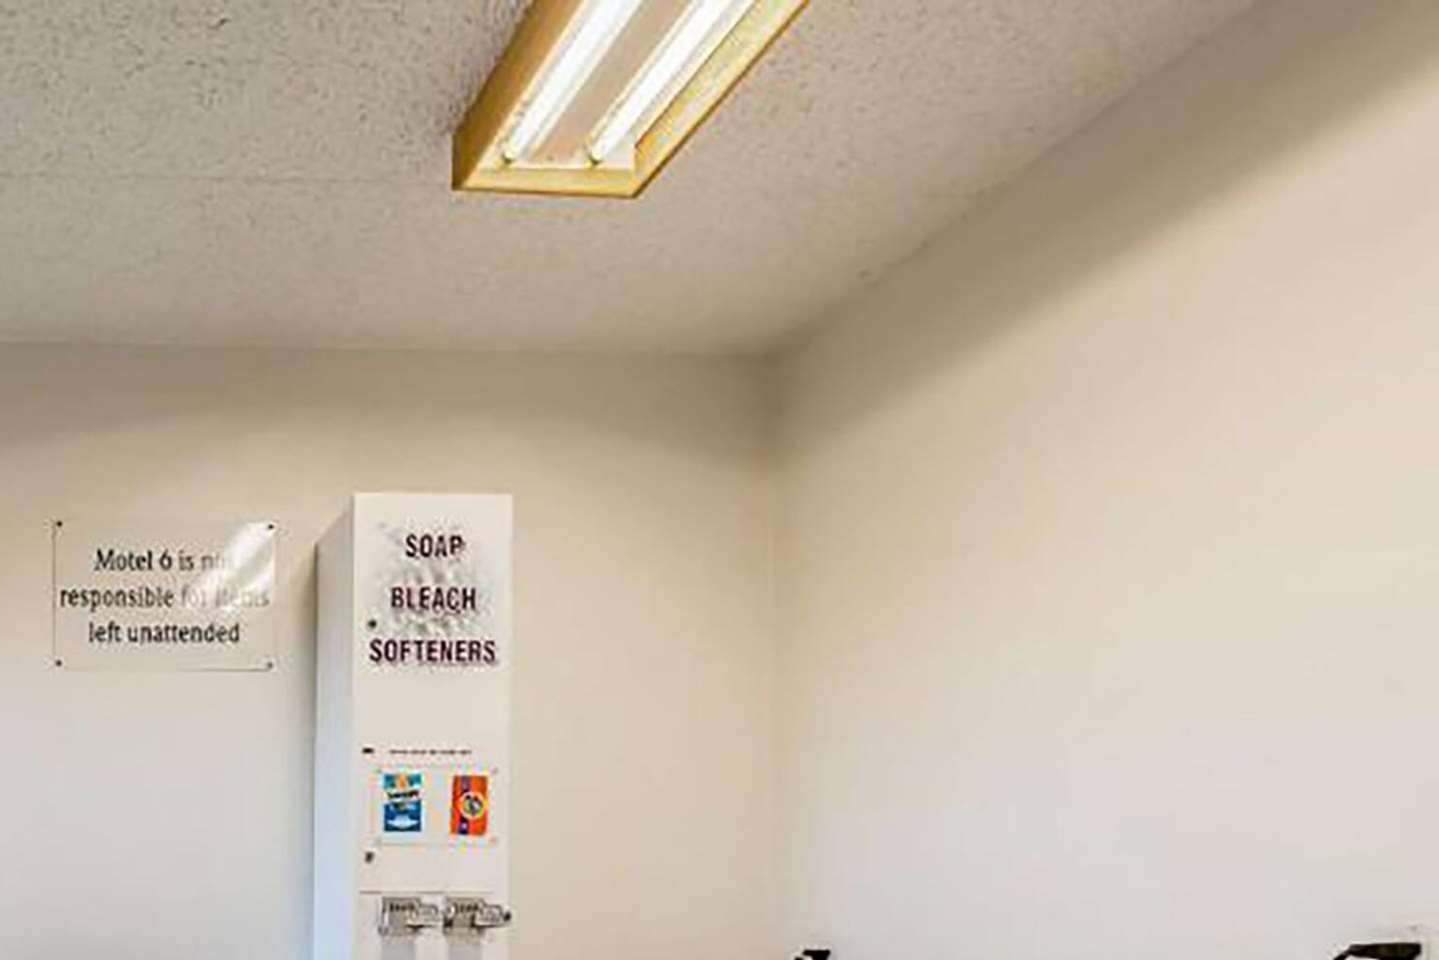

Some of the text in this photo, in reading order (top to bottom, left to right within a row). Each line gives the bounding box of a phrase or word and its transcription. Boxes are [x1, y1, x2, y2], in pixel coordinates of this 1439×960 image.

[405, 533, 465, 557] SOAP
[94, 550, 152, 571] Motel
[159, 551, 172, 571] 6
[179, 551, 194, 571] is
[60, 589, 174, 611] responsible
[390, 586, 476, 611] BLEACH
[89, 622, 240, 644] left unattended
[369, 638, 496, 663] SOFTENERS
